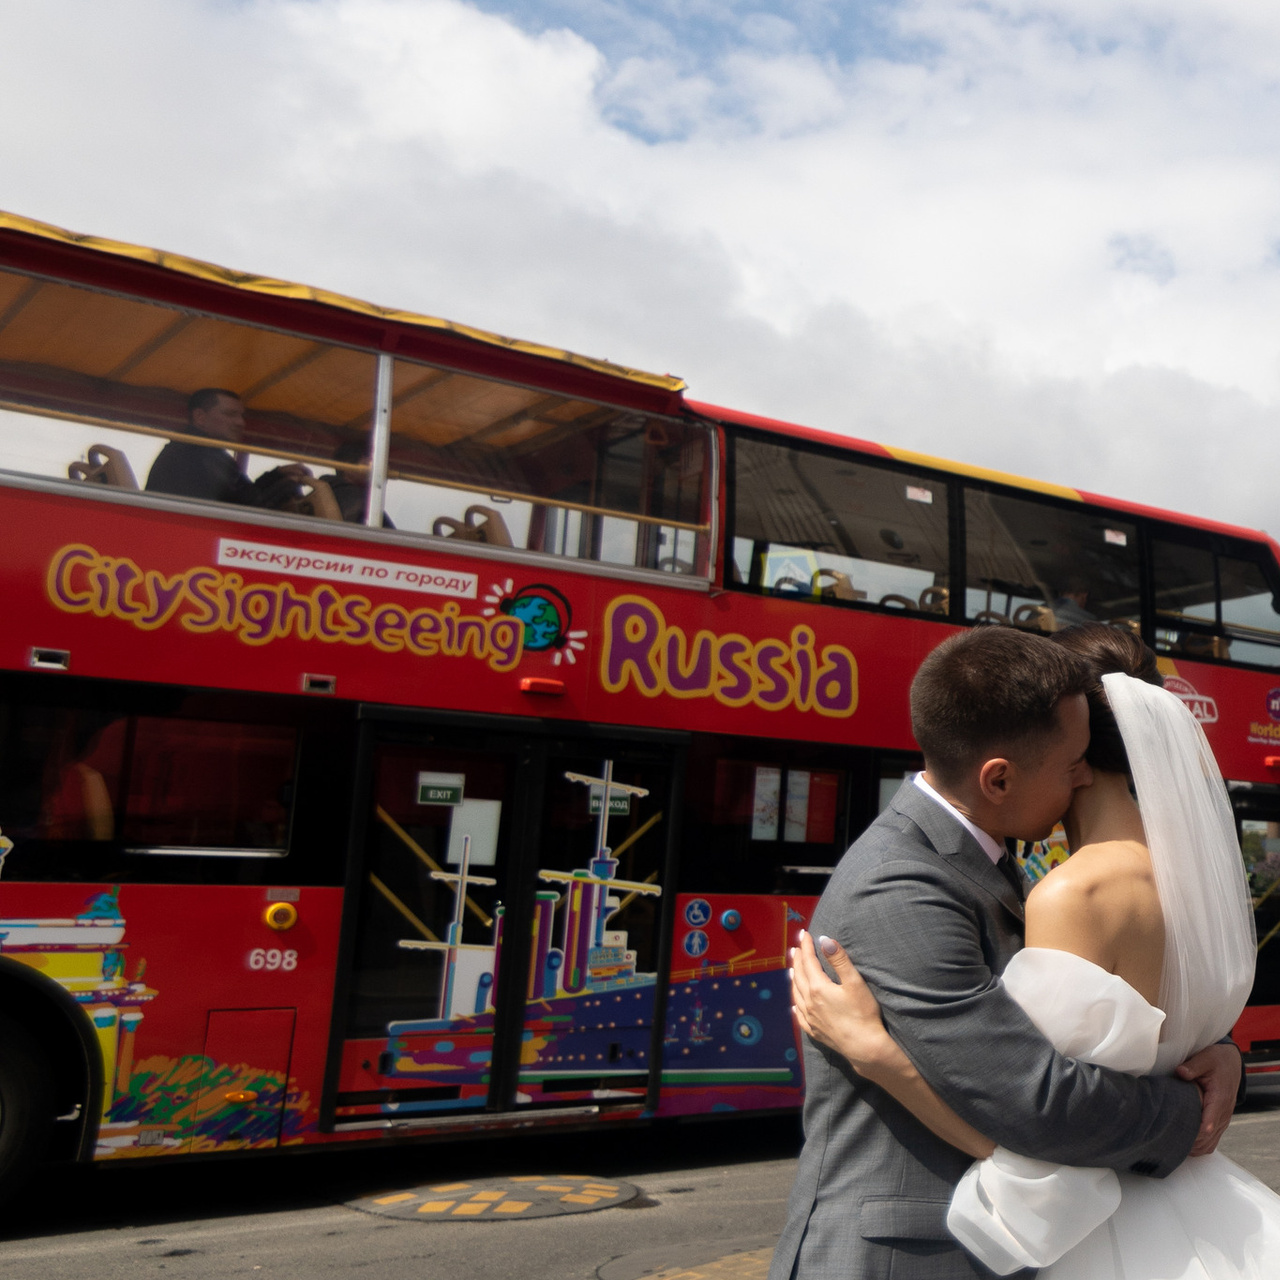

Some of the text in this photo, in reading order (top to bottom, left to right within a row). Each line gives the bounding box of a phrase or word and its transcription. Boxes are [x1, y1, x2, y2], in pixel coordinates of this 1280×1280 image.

[224, 546, 472, 593] экскурсии по городу
[601, 594, 859, 718] Russia
[429, 789, 453, 800] EXIT
[249, 948, 298, 971] 698
